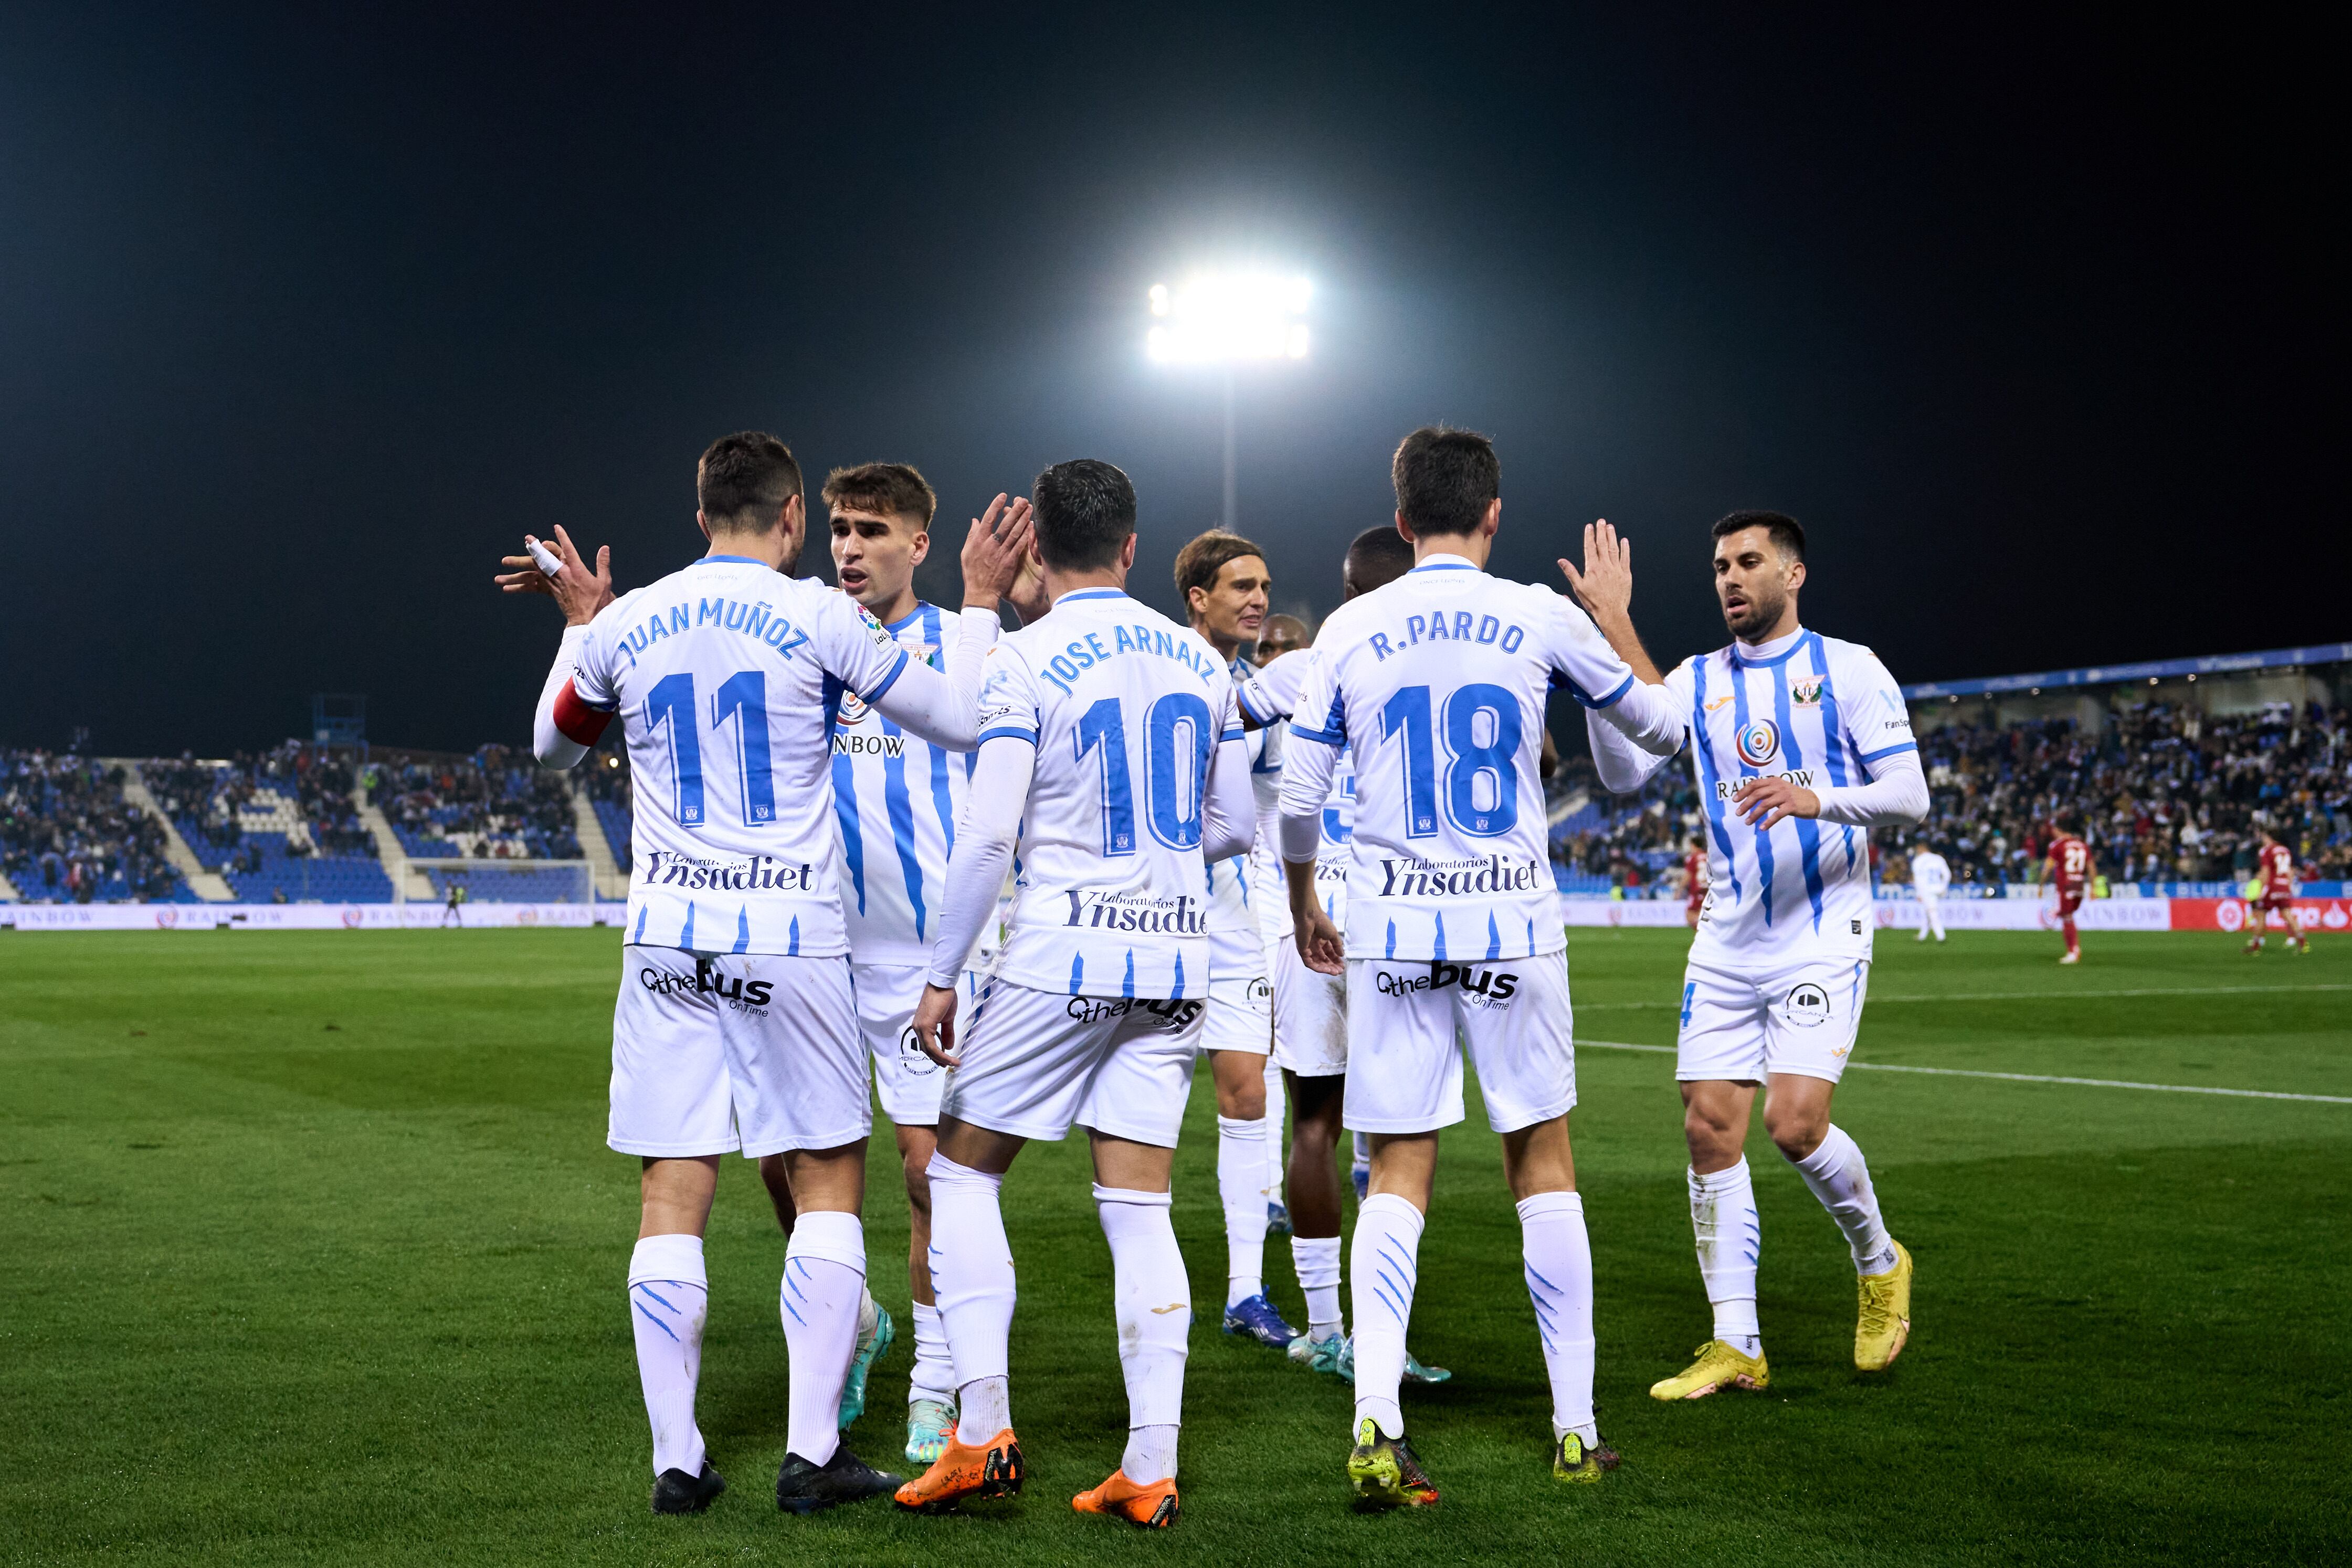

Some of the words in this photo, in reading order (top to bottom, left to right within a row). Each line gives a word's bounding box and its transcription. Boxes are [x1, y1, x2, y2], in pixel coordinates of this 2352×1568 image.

[617, 602, 690, 671] JUAN
[697, 597, 808, 661] MUÑOZ
[1039, 632, 1112, 698] JOSE
[1113, 624, 1216, 687] ARNAIZ
[1368, 610, 1524, 662] R.PARDO
[642, 670, 776, 828] 11
[1072, 692, 1211, 858] 10
[1378, 683, 1522, 840] 18
[642, 852, 813, 891] Ynsadiet
[1378, 854, 1539, 896] Ynsadiet
[1410, 856, 1489, 871] Laboratorios
[1101, 892, 1175, 909] Laboratorios
